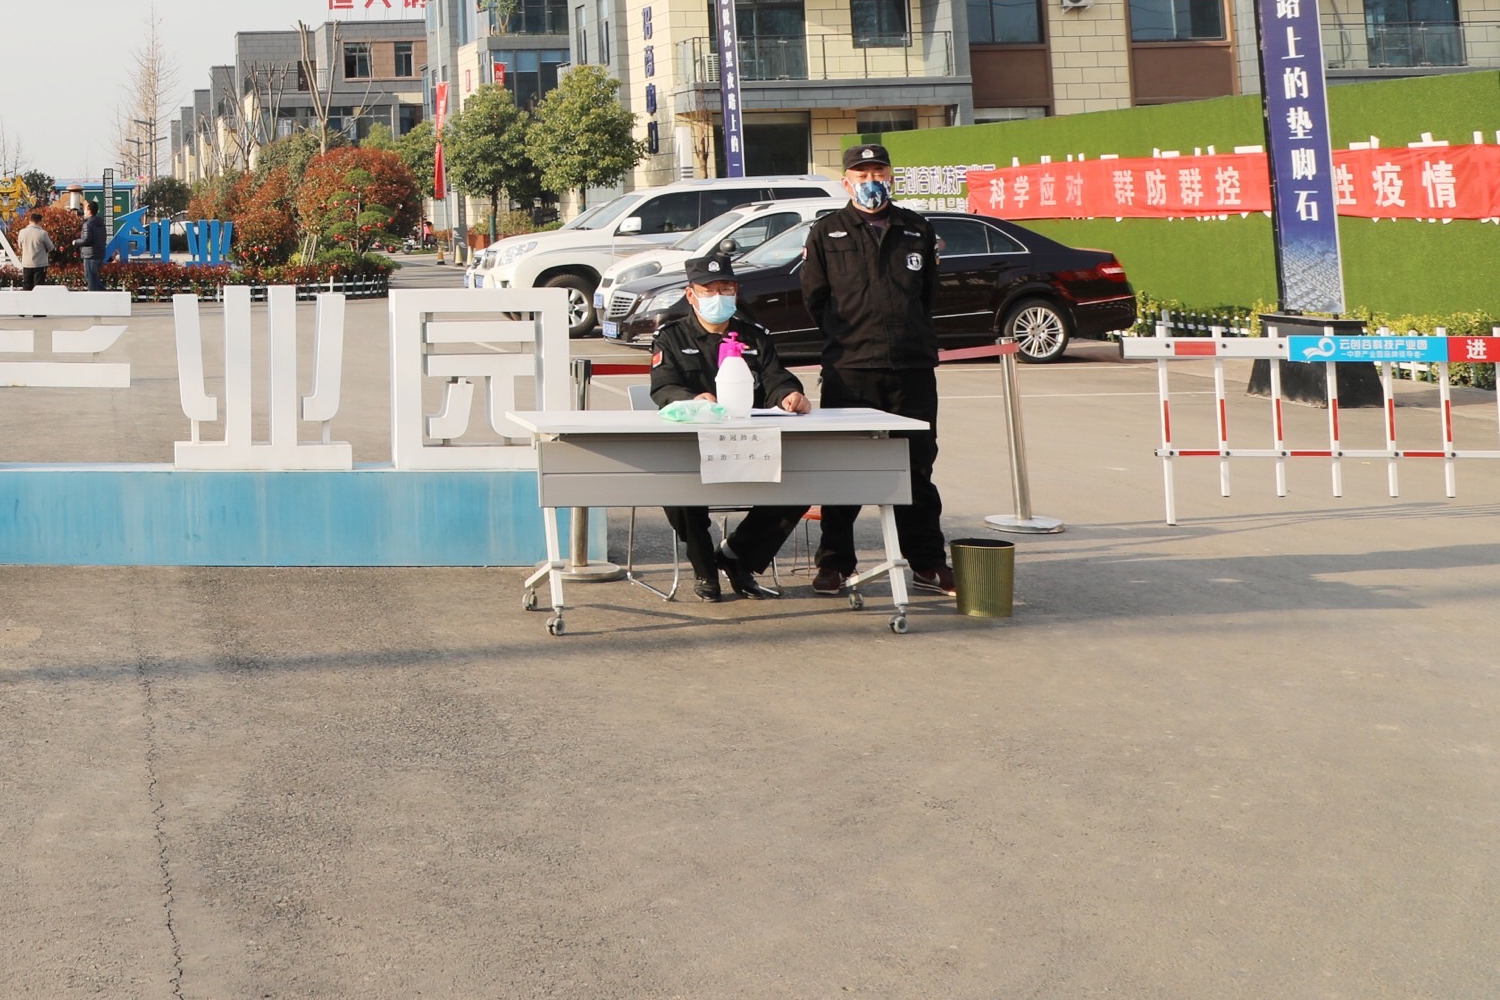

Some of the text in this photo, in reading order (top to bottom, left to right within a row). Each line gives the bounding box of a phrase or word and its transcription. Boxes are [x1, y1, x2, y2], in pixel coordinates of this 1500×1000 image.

[893, 164, 997, 195] 云创谷科技产
[989, 172, 1084, 209] 科学应对
[1111, 166, 1242, 207] 群防群控
[1339, 339, 1488, 360] 云创谷科技产业园 进
